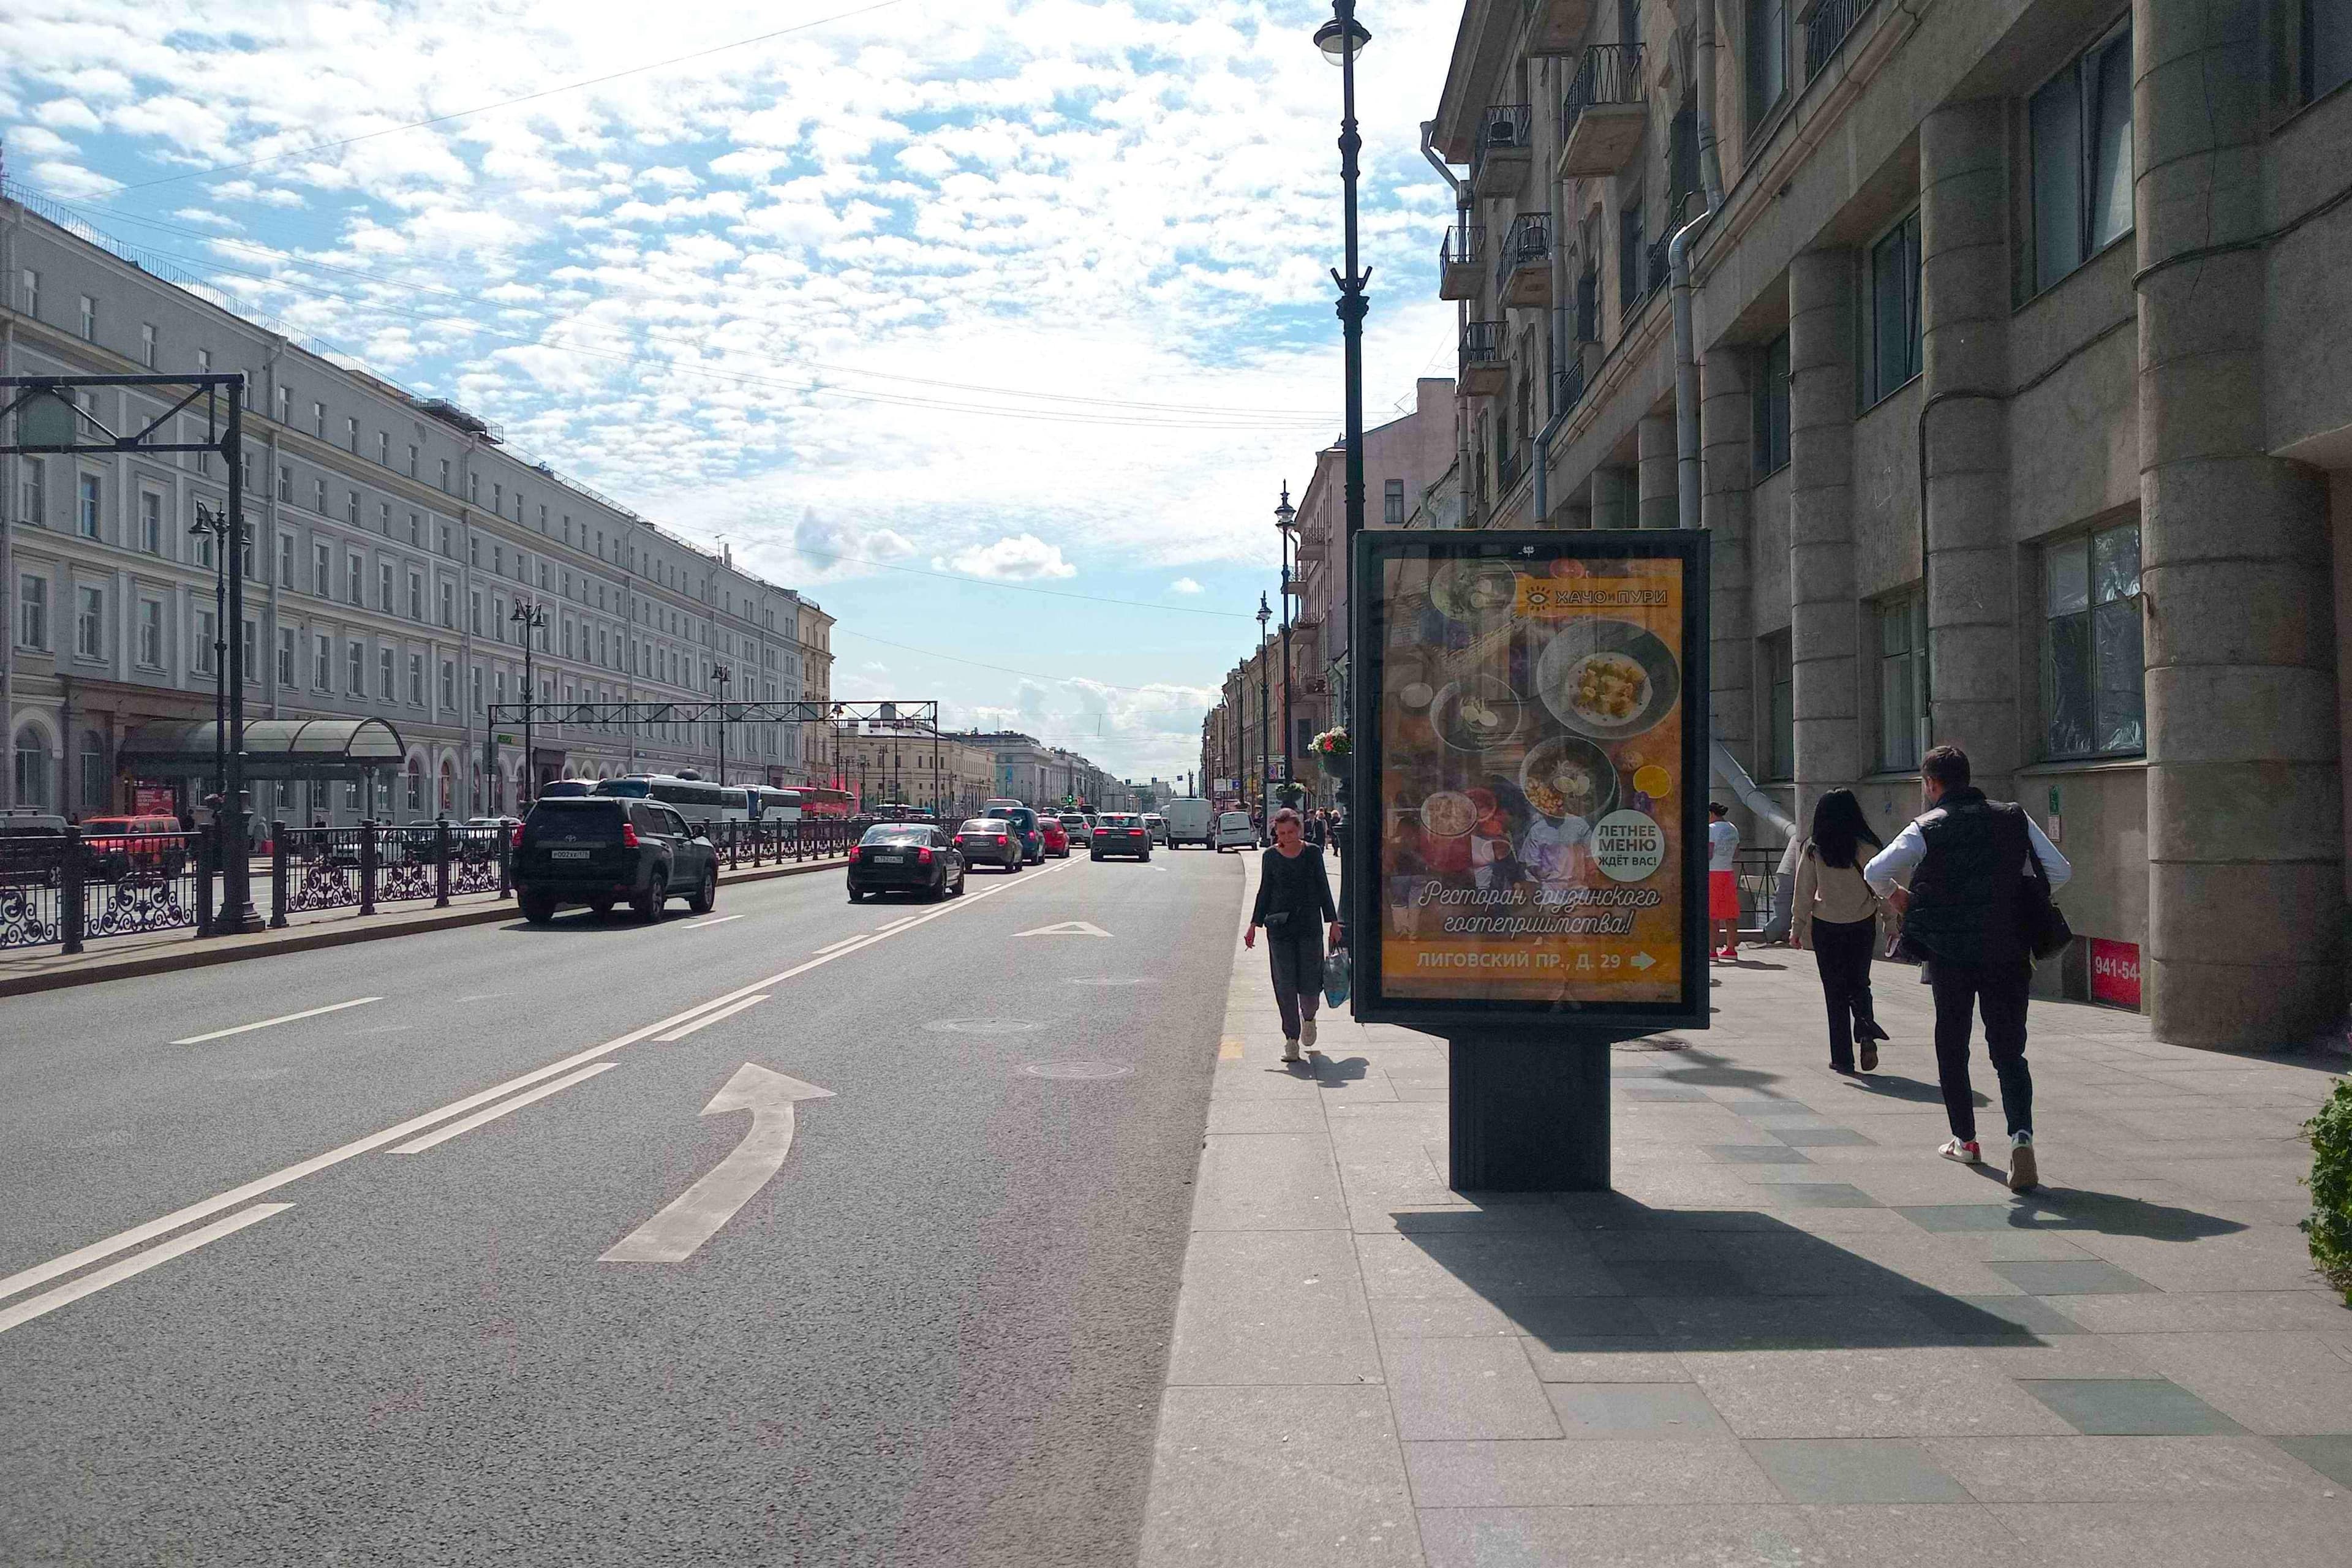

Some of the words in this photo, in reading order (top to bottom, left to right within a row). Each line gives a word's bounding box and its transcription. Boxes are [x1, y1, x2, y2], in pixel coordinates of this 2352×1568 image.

[1556, 590, 1608, 603] ХАЧО
[1617, 590, 1667, 603] ПУРИ
[1598, 825, 1656, 837] ЛЕТНЕЕ
[1599, 839, 1657, 851] МЕНЮ
[1598, 854, 1629, 867] ЖДЁТ
[1632, 857, 1657, 865] ВАС!
[1418, 880, 1527, 911] Ресторан
[1532, 886, 1661, 914] грузинского
[1444, 911, 1635, 940] гостеприимства!
[1416, 951, 1529, 968] ЛИГОВСКИЙ
[1600, 954, 1621, 968] 29
